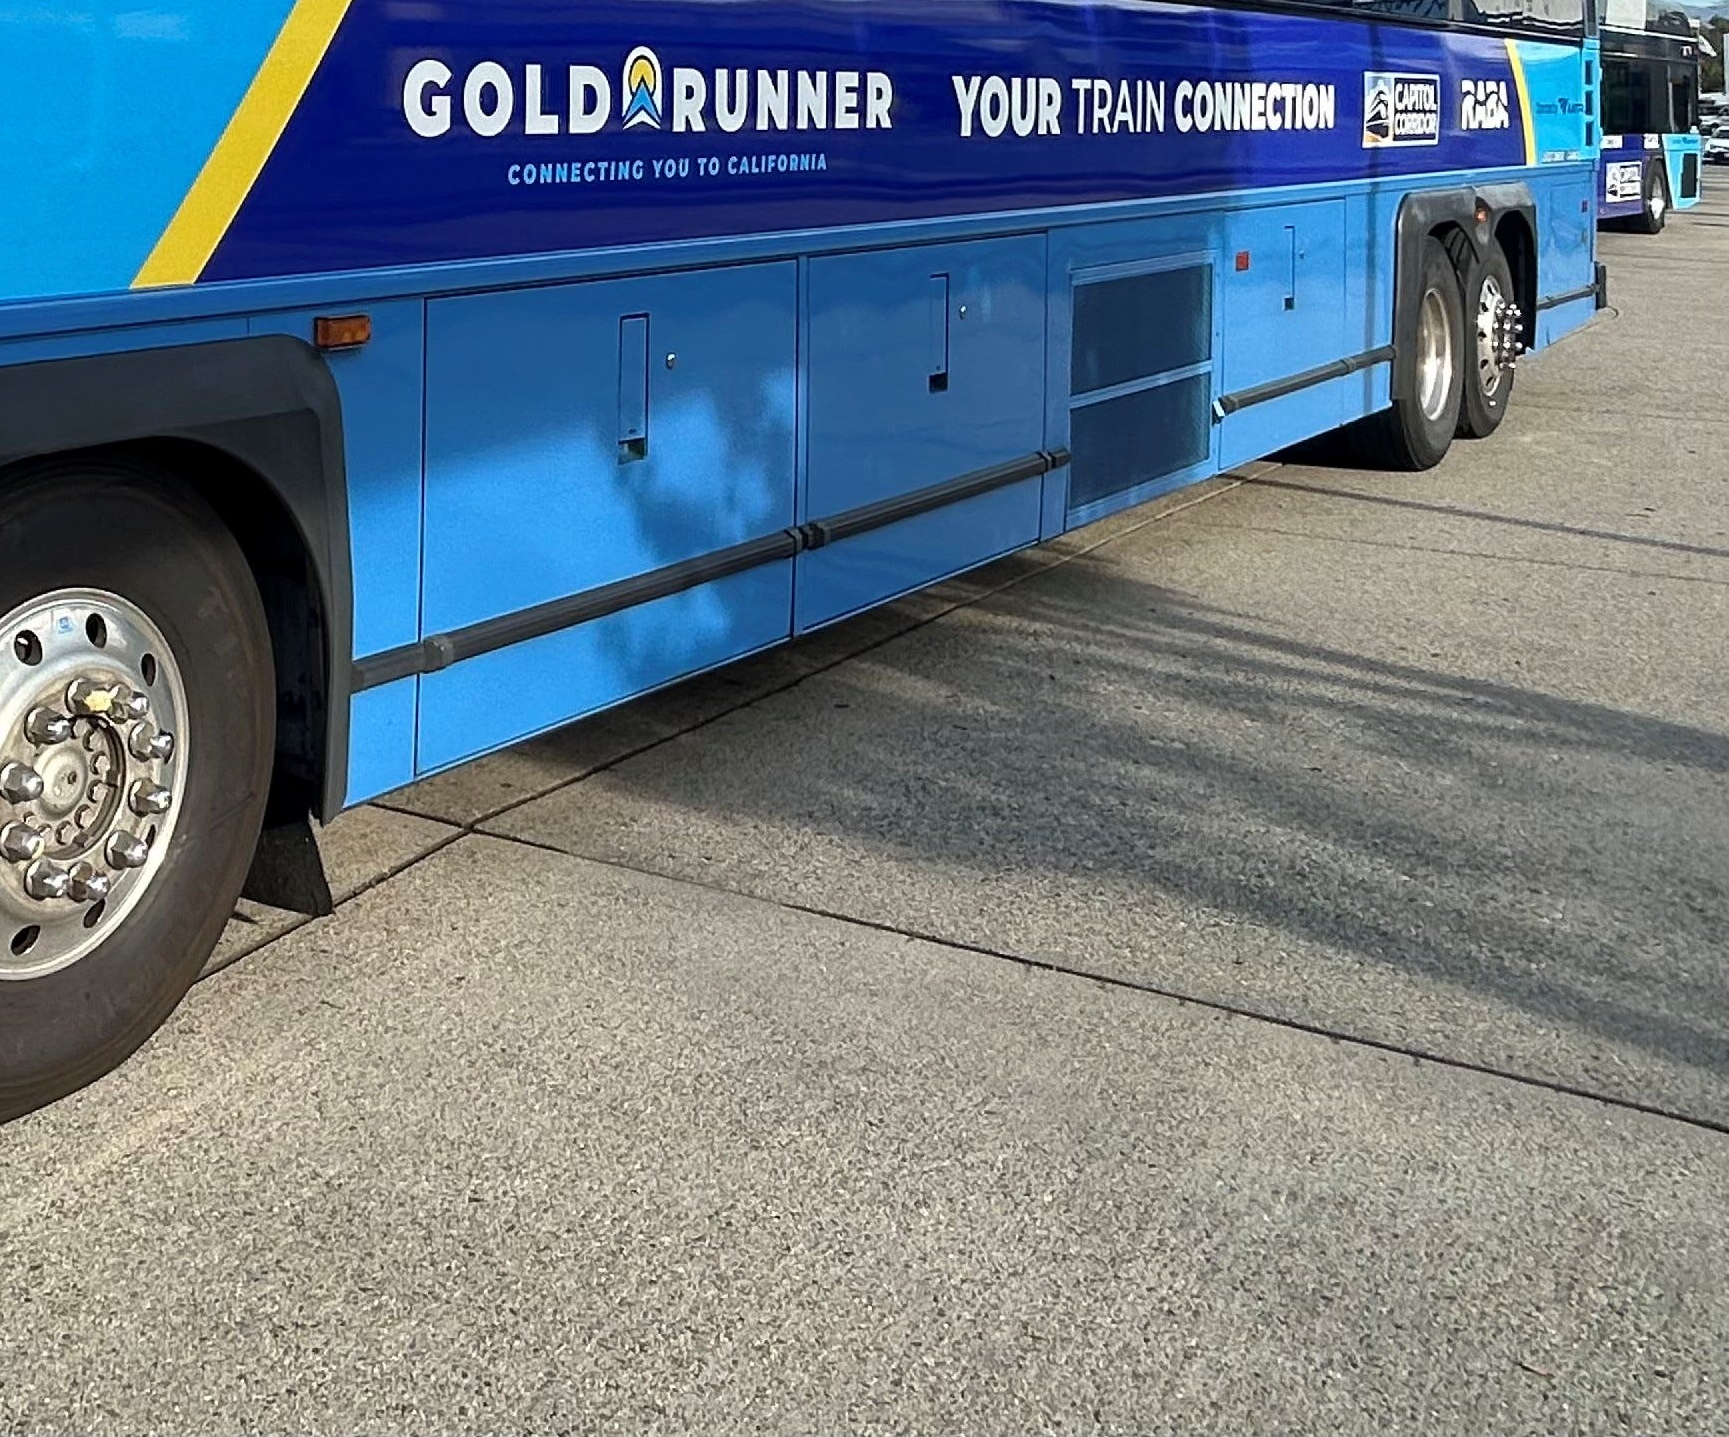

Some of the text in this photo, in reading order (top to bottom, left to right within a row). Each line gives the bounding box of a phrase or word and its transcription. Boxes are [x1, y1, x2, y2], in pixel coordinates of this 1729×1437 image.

[403, 58, 893, 138] GOLD RUNNER
[951, 74, 1335, 138] YOUR TRAIN CONNECTION
[1394, 83, 1438, 111] CAPITOL
[507, 153, 828, 186] CONNECTING YOU TO CALIFORNIA
